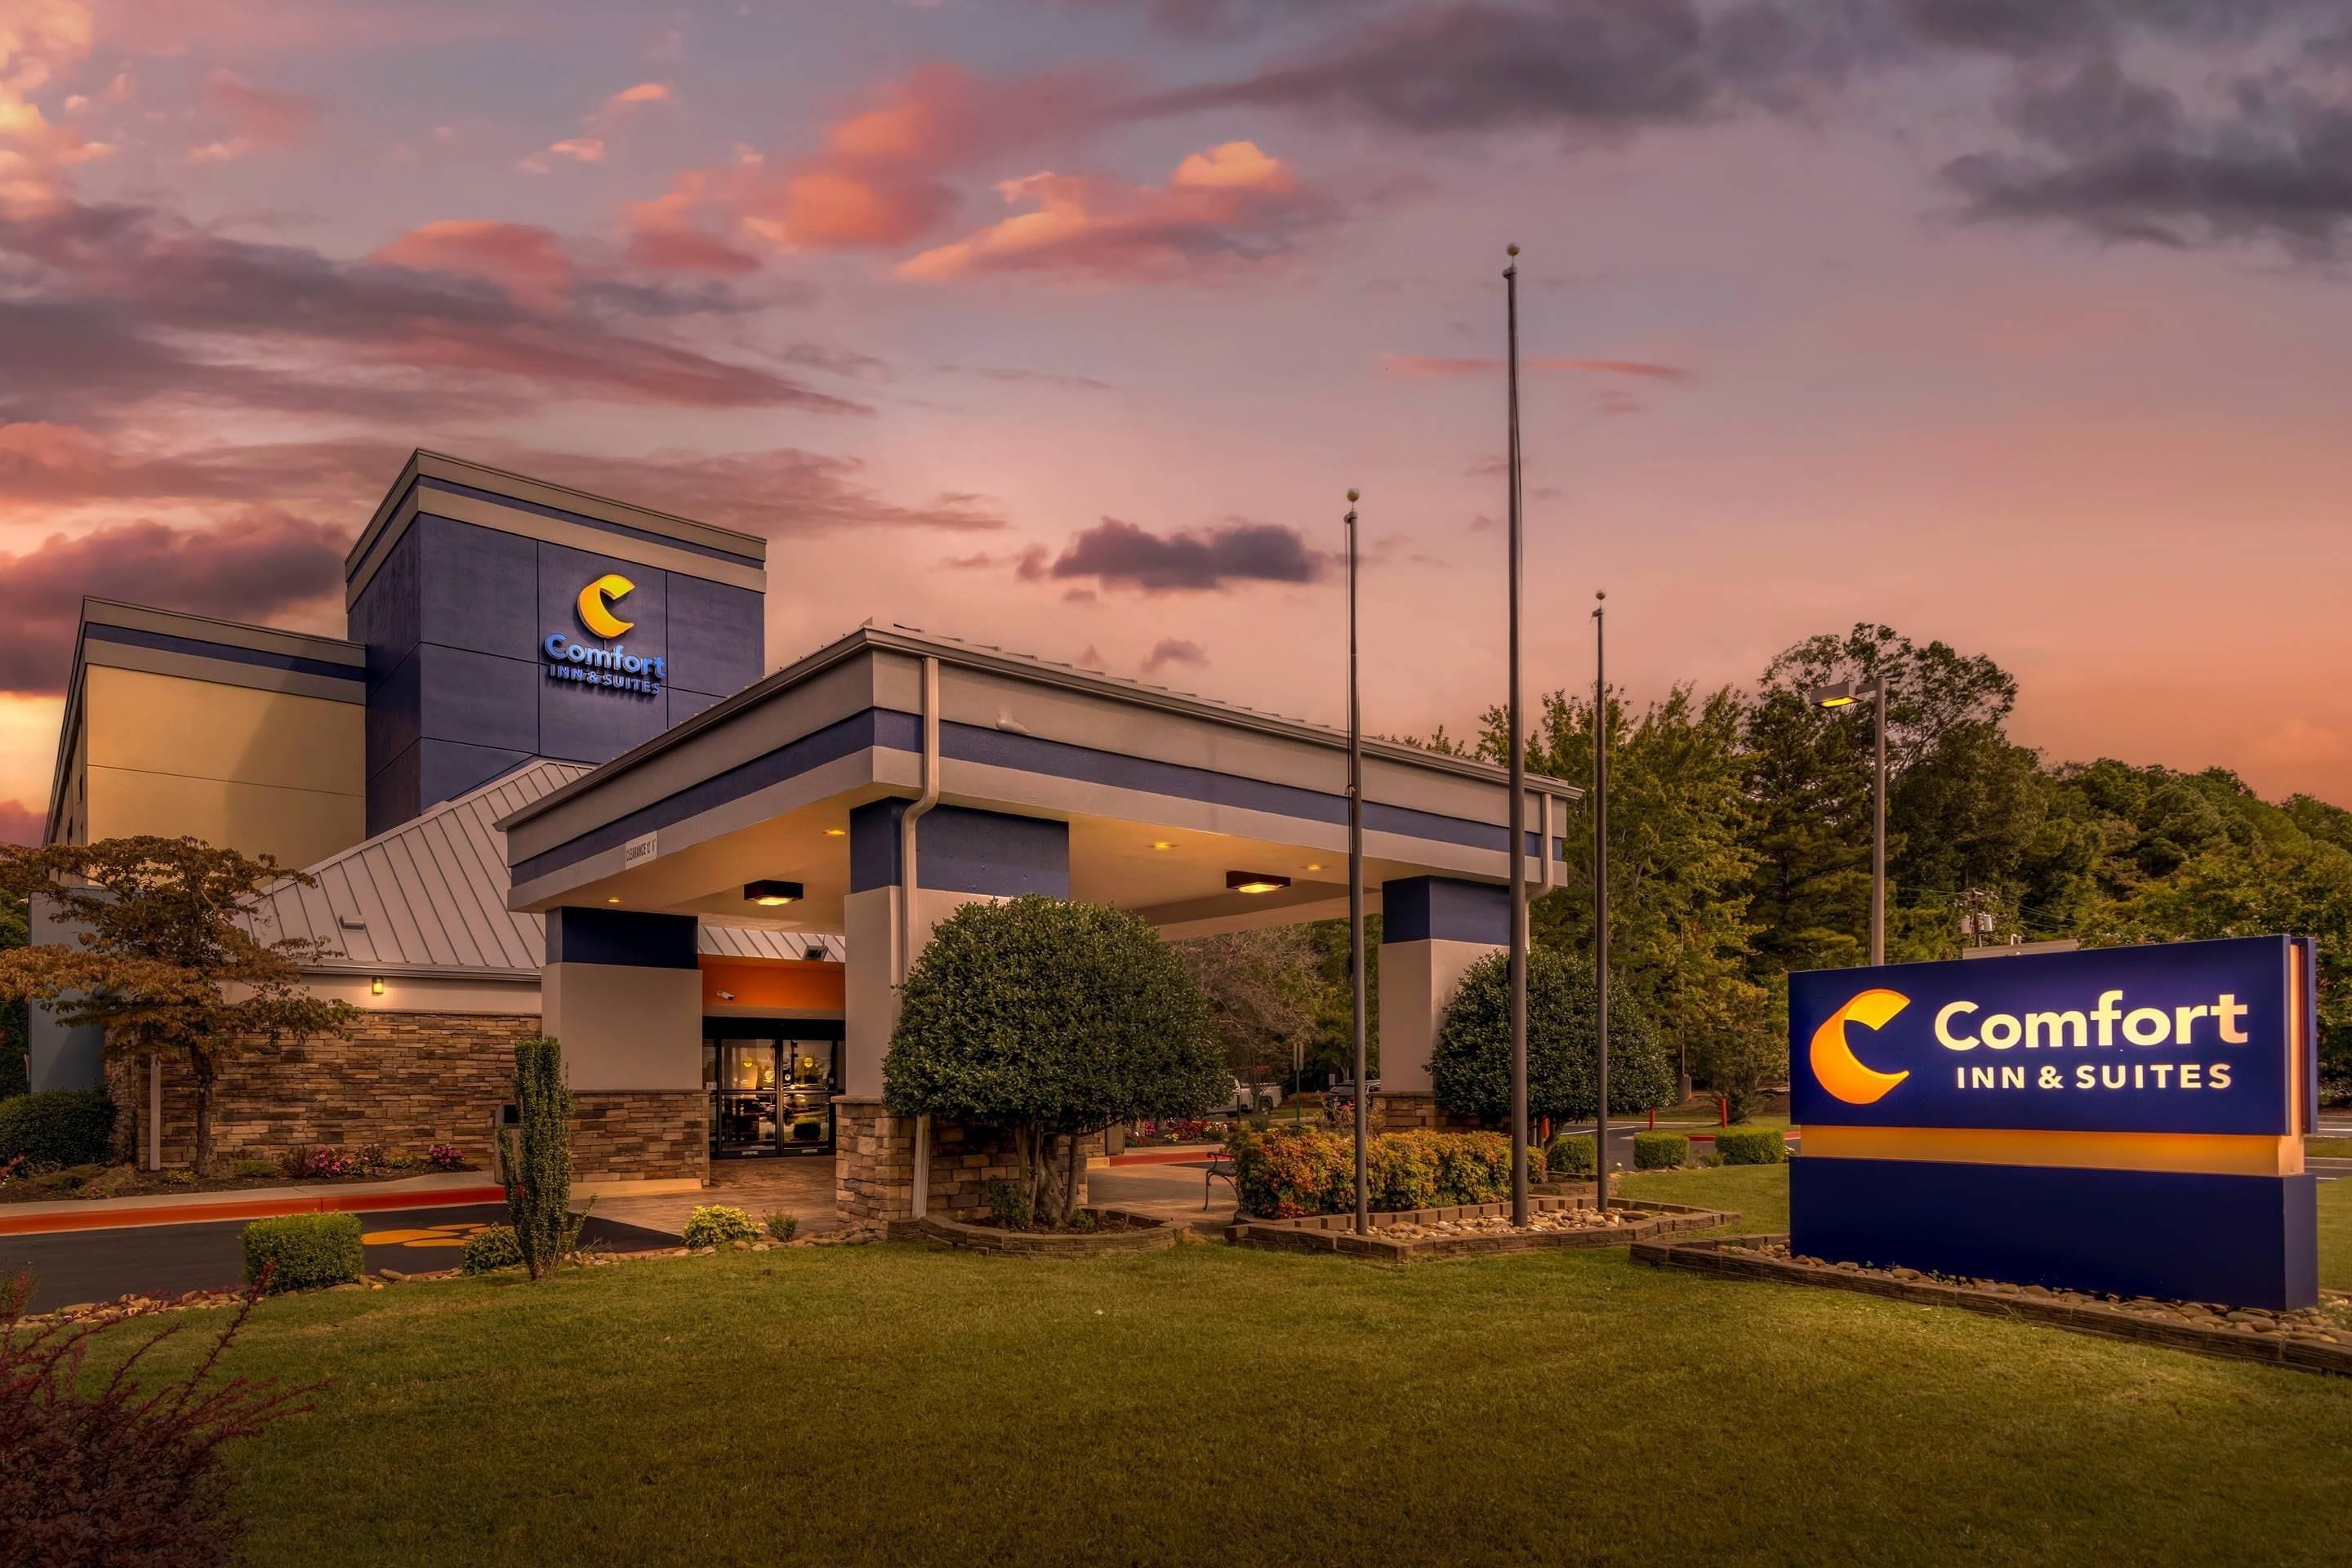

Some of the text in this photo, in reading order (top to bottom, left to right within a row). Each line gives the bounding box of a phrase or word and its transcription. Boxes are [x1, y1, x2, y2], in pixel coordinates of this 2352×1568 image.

[544, 633, 666, 678] Comfort
[550, 664, 661, 694] INN & SUITES
[1934, 990, 2248, 1051] Comfort
[1957, 1063, 2232, 1089] INN & SUITES
